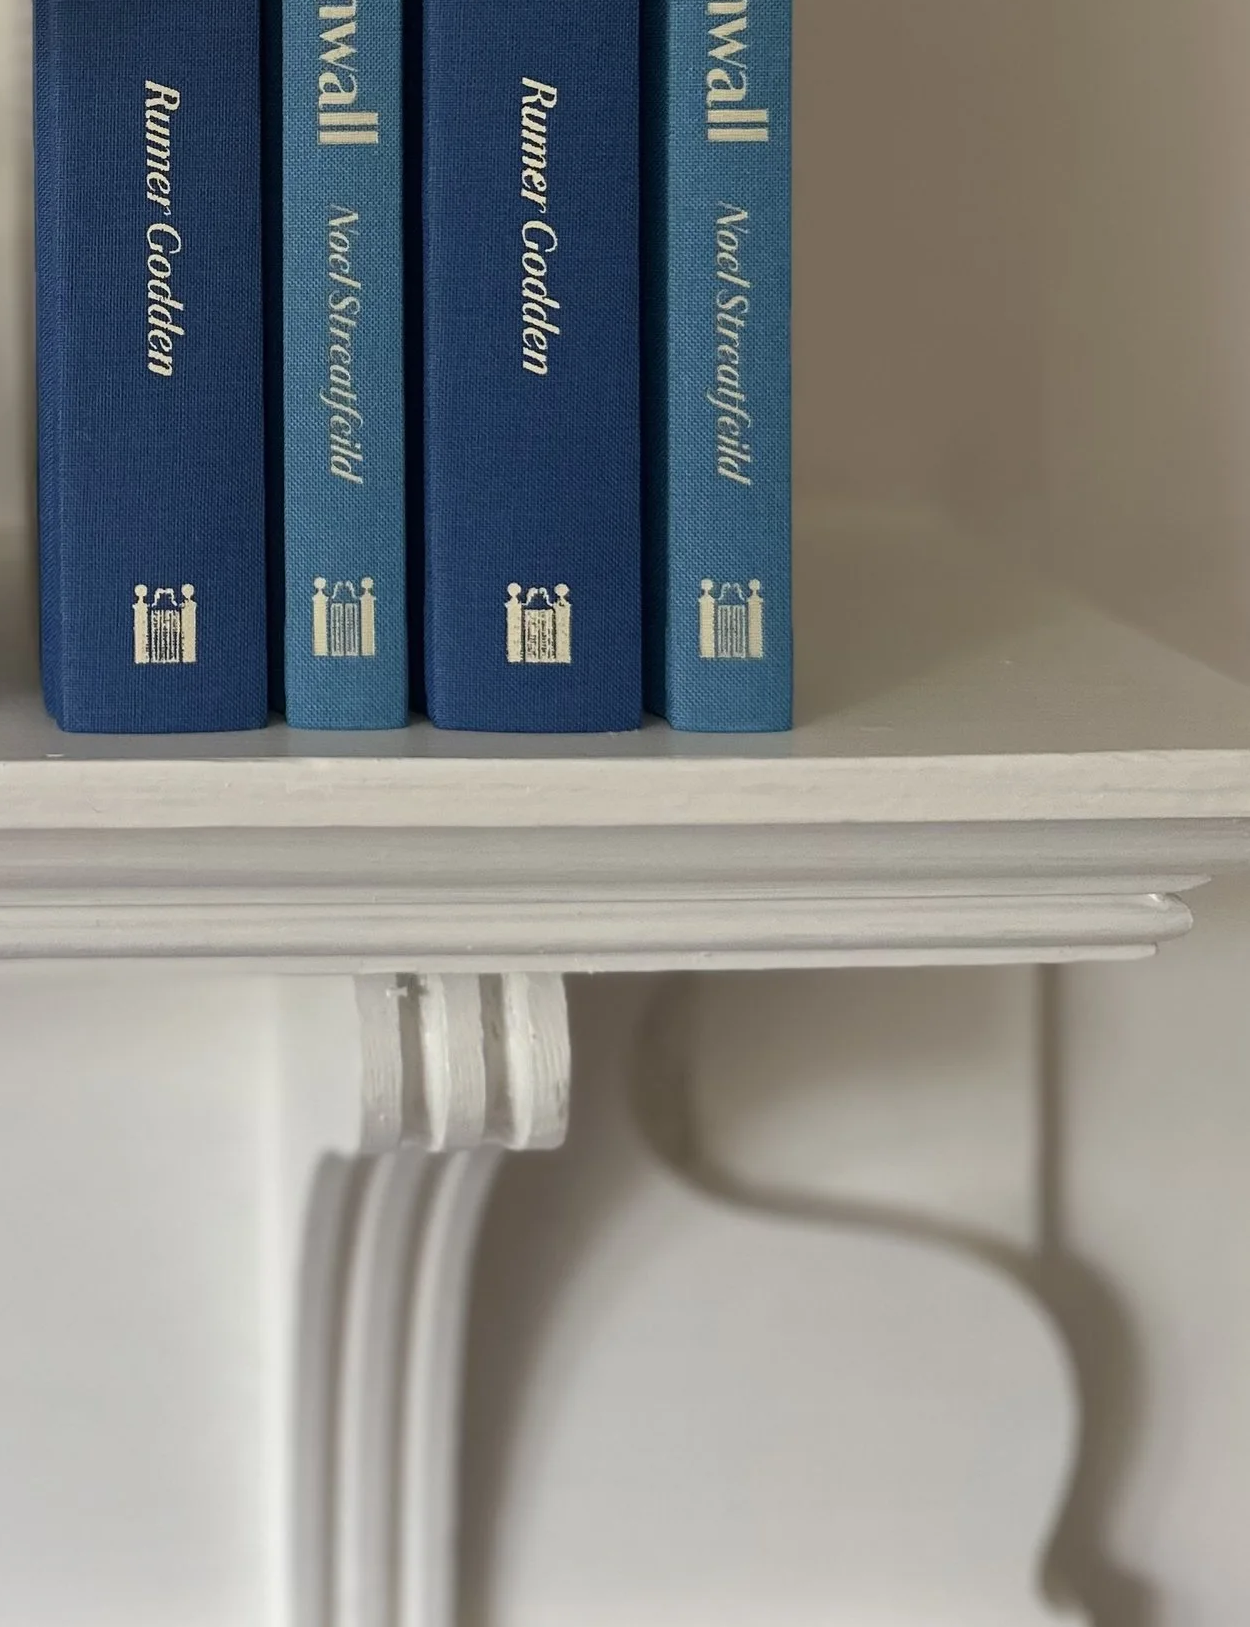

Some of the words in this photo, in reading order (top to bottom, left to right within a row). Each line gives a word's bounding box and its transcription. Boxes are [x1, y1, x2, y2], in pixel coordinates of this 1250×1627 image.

[143, 79, 181, 216] Rumer
[519, 77, 559, 214] Rumer
[145, 222, 186, 377] Godden
[327, 207, 362, 290] Noel
[521, 220, 562, 376] Godden
[716, 202, 751, 290] Noel
[318, 293, 364, 485] Streatfeild
[705, 293, 752, 486] Streatfeild
